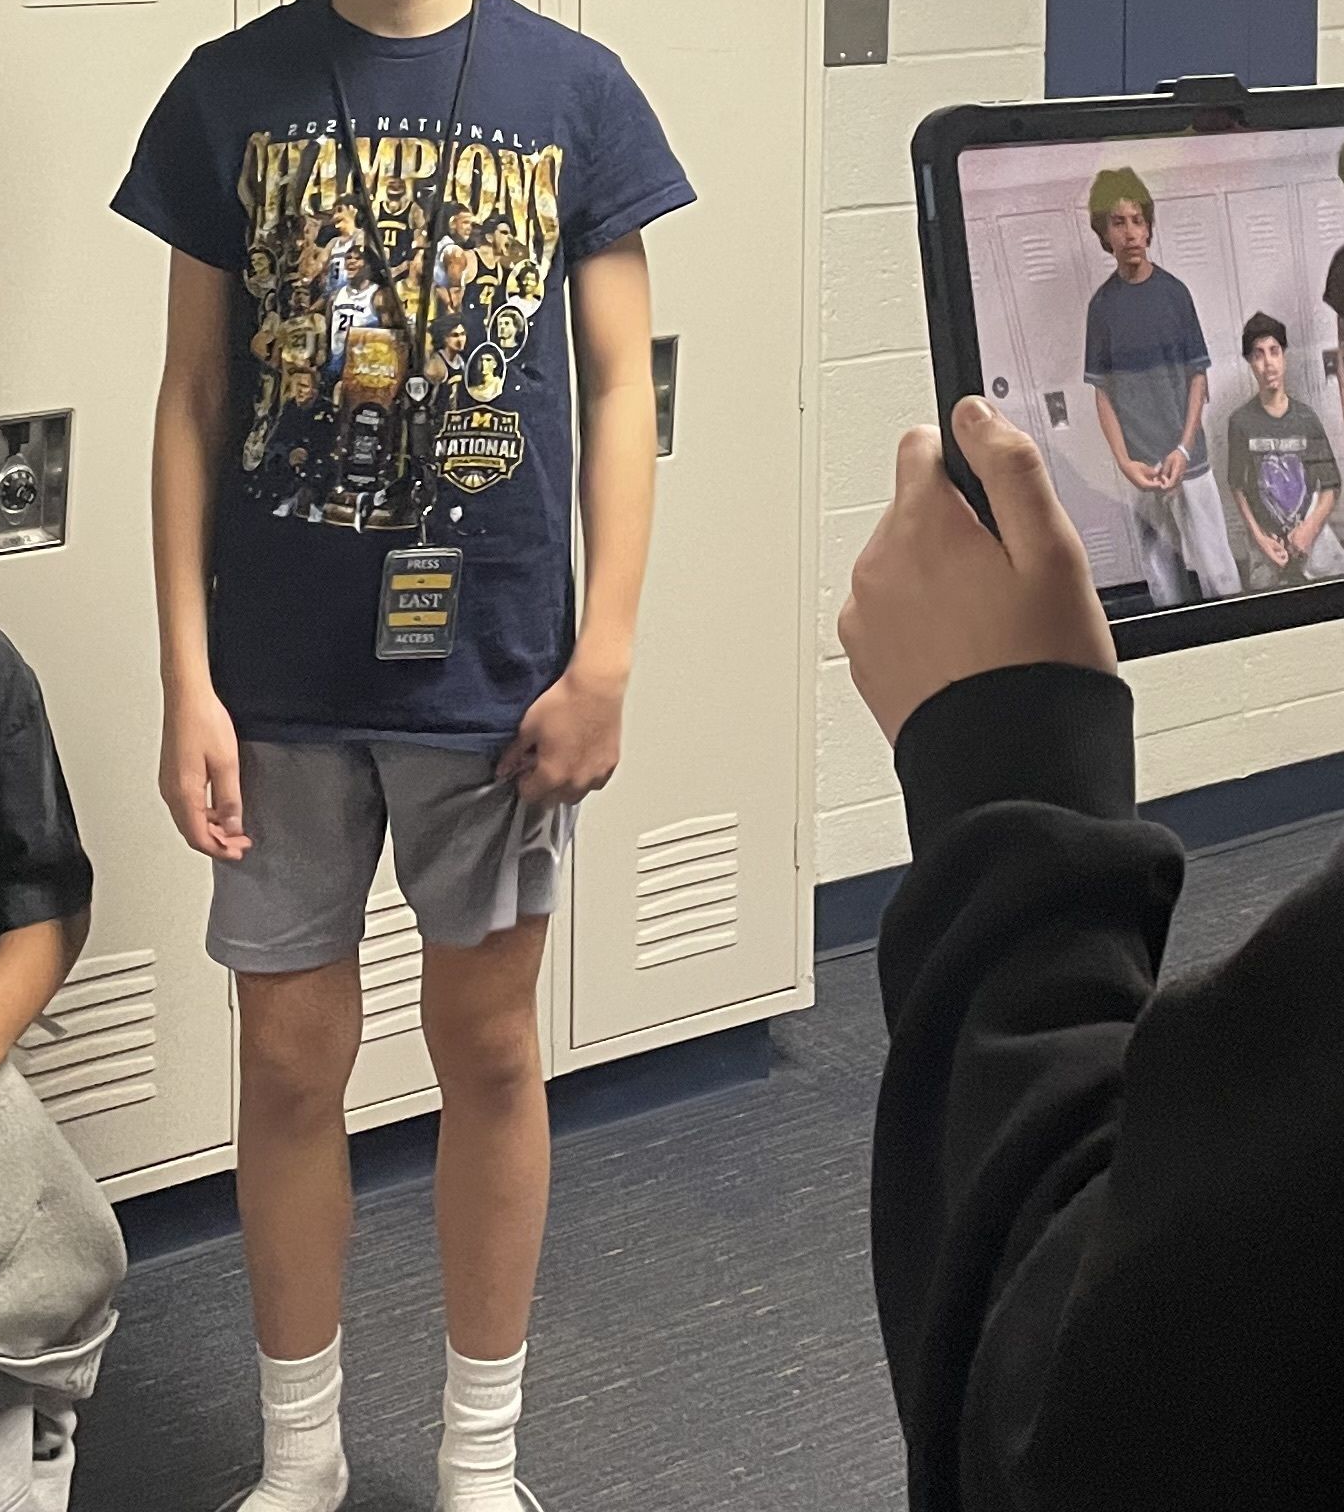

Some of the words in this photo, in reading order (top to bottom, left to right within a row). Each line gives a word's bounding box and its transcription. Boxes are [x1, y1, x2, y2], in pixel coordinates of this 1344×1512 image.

[434, 437, 519, 459] NATIONAL
[407, 558, 440, 569] PRESS
[399, 593, 443, 609] EAST
[395, 633, 435, 644] ACCESS
